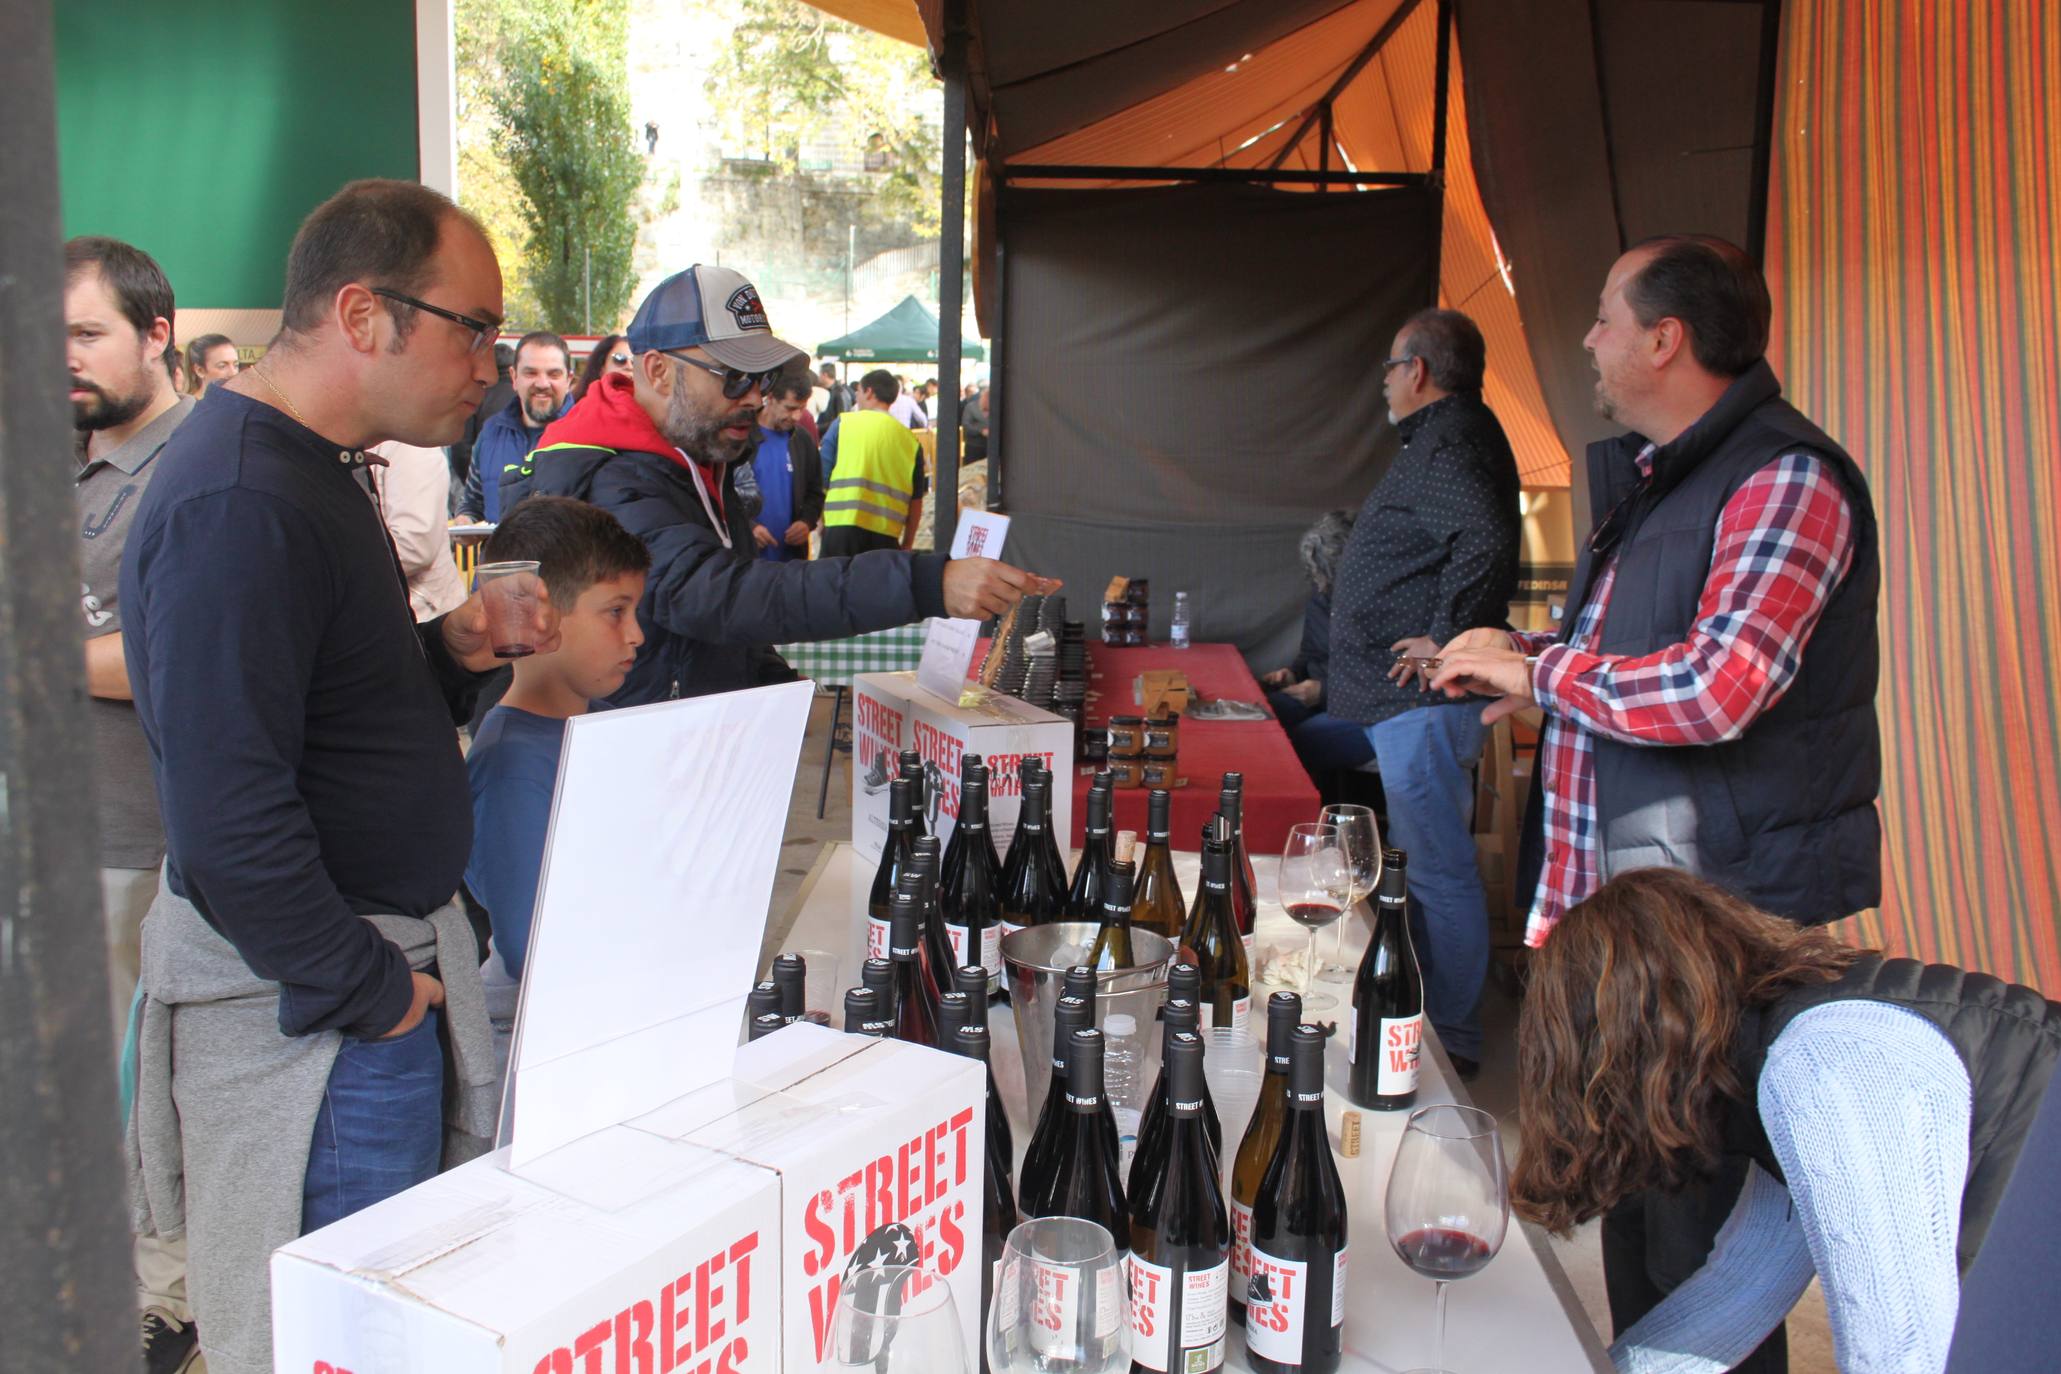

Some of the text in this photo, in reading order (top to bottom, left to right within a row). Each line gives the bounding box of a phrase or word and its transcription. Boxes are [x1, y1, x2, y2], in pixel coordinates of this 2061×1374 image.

[857, 692, 902, 748] STREET
[859, 730, 901, 783] WIES
[912, 719, 964, 778] STREET
[987, 752, 1054, 774] STRT
[1075, 1097, 1097, 1106] WINES
[1175, 1101, 1198, 1111] STREET
[1298, 1092, 1321, 1102] STREET
[803, 1106, 973, 1277] STREET
[808, 1199, 965, 1364] WES
[1188, 1273, 1211, 1283] STREET
[1188, 1281, 1211, 1290] WINES
